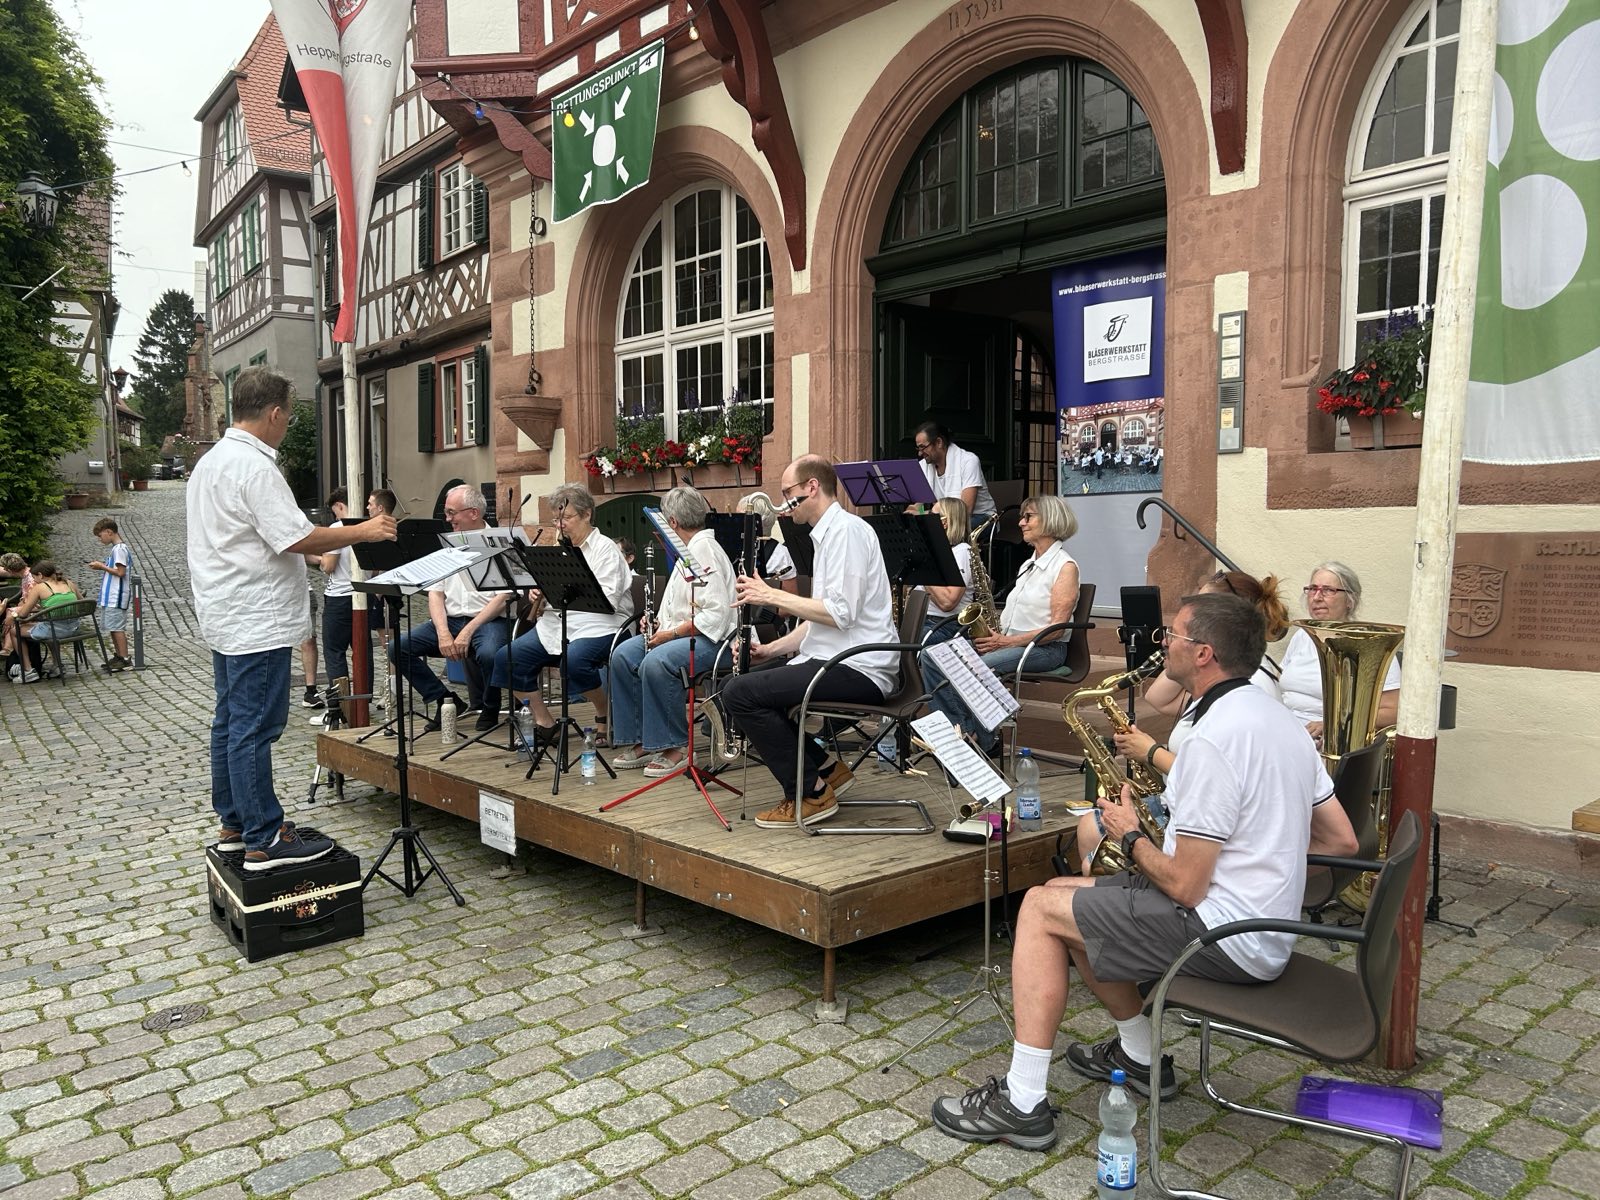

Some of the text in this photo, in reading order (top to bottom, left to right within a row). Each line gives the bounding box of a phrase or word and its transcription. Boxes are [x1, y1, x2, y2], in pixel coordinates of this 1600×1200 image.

[556, 60, 638, 116] RETTUNGSPUNKT
[1058, 271, 1167, 296] www.blaeserwerkstatt-bergstrass
[1088, 343, 1147, 359] BLÄSERWERKSTATT
[1088, 353, 1146, 366] BERGSTRASSE
[1536, 540, 1600, 556] RATH
